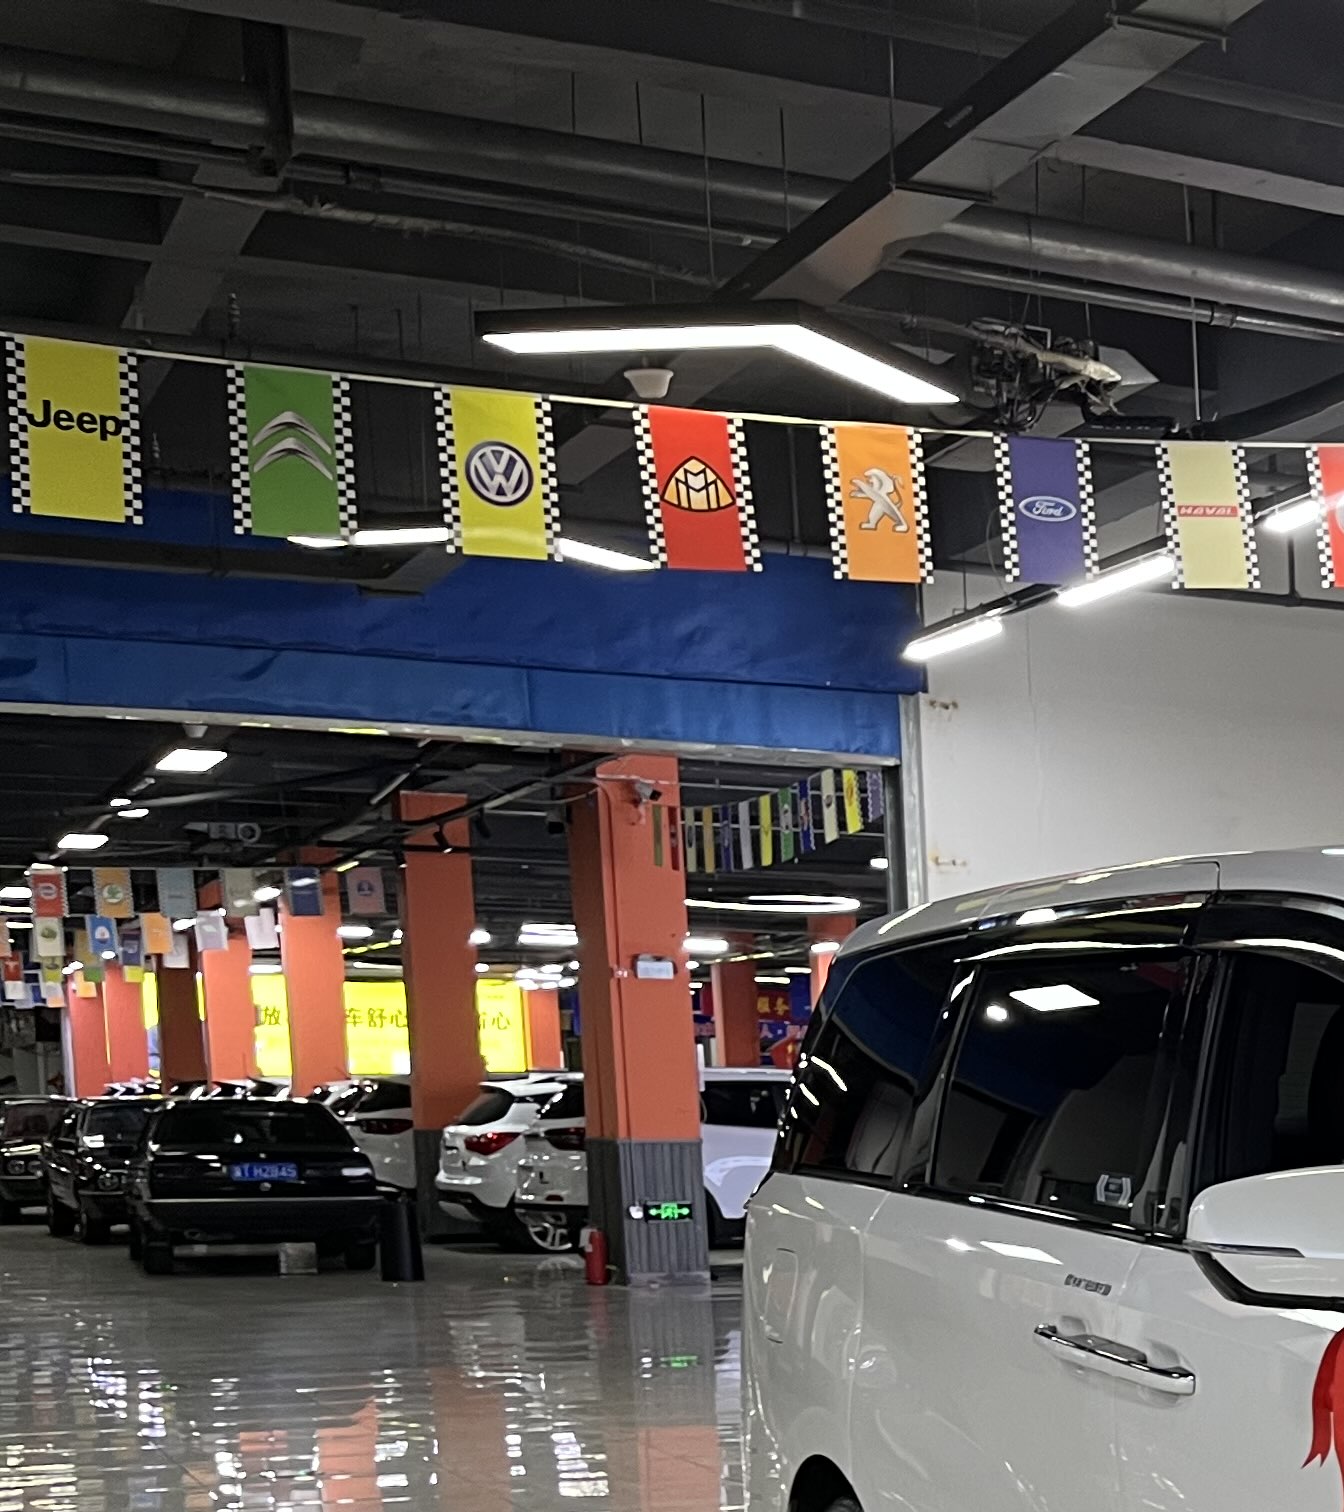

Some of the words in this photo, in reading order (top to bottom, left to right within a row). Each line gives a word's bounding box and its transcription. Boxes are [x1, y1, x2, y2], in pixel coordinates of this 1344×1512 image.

[26, 399, 121, 441] Jeep
[1031, 500, 1065, 517] Ford
[1179, 505, 1235, 517] HAVAL
